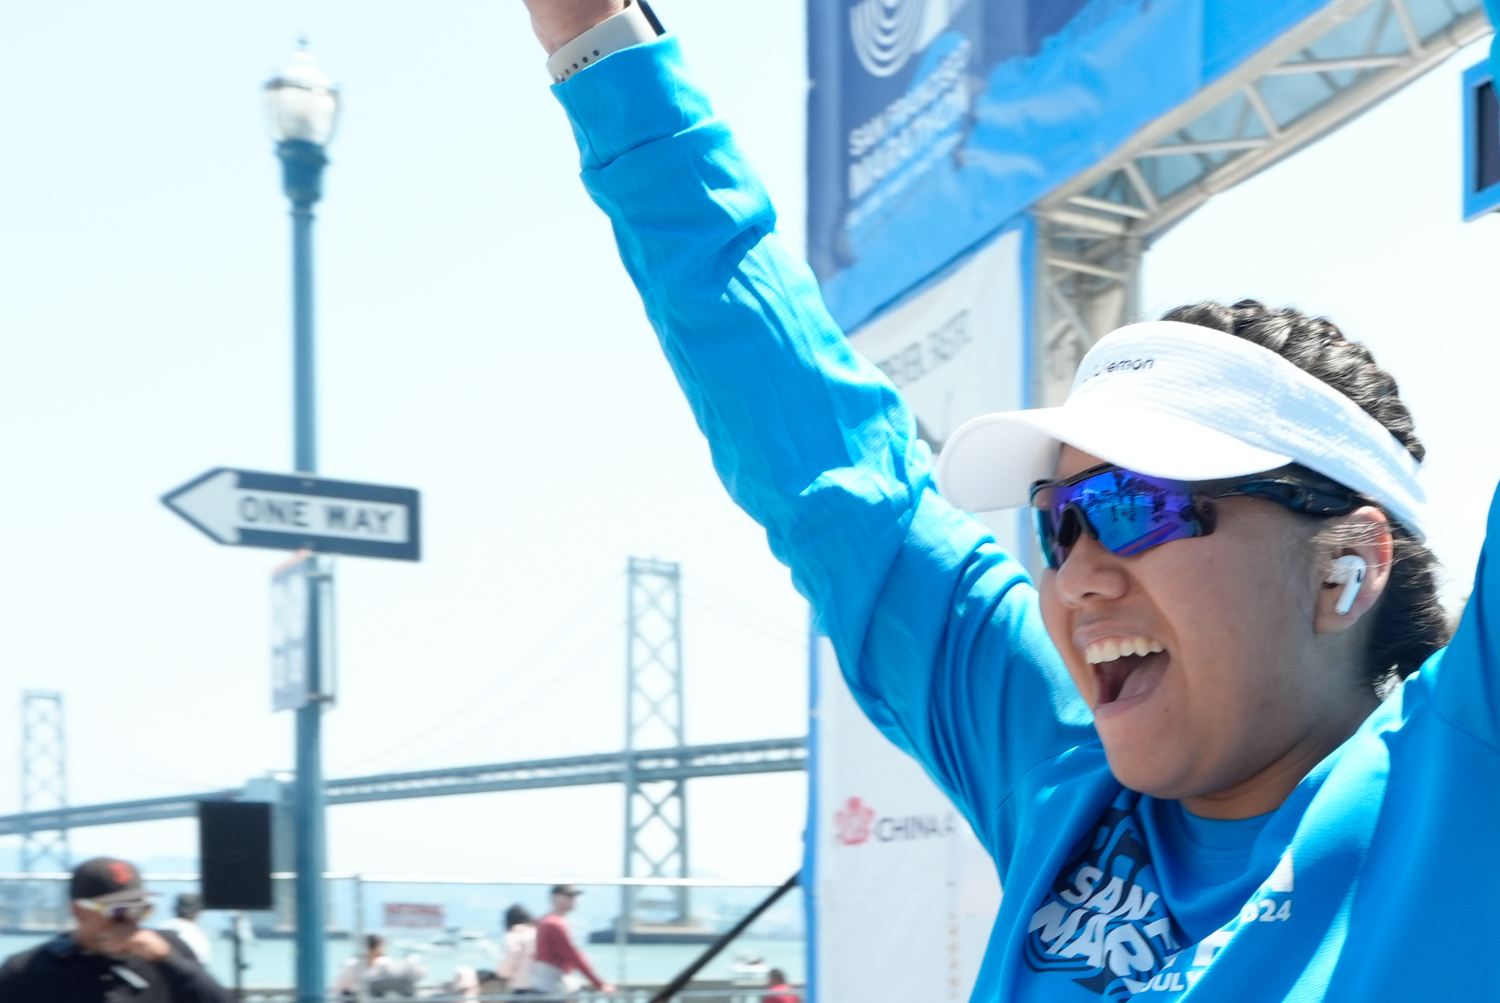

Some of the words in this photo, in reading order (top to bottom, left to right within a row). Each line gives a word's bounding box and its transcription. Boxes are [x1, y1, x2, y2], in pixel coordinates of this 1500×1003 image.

[238, 496, 310, 527] ONE
[325, 503, 395, 535] WAY
[874, 814, 943, 842] CHINA
[1060, 866, 1160, 920] SAN
[1240, 899, 1293, 924] 024
